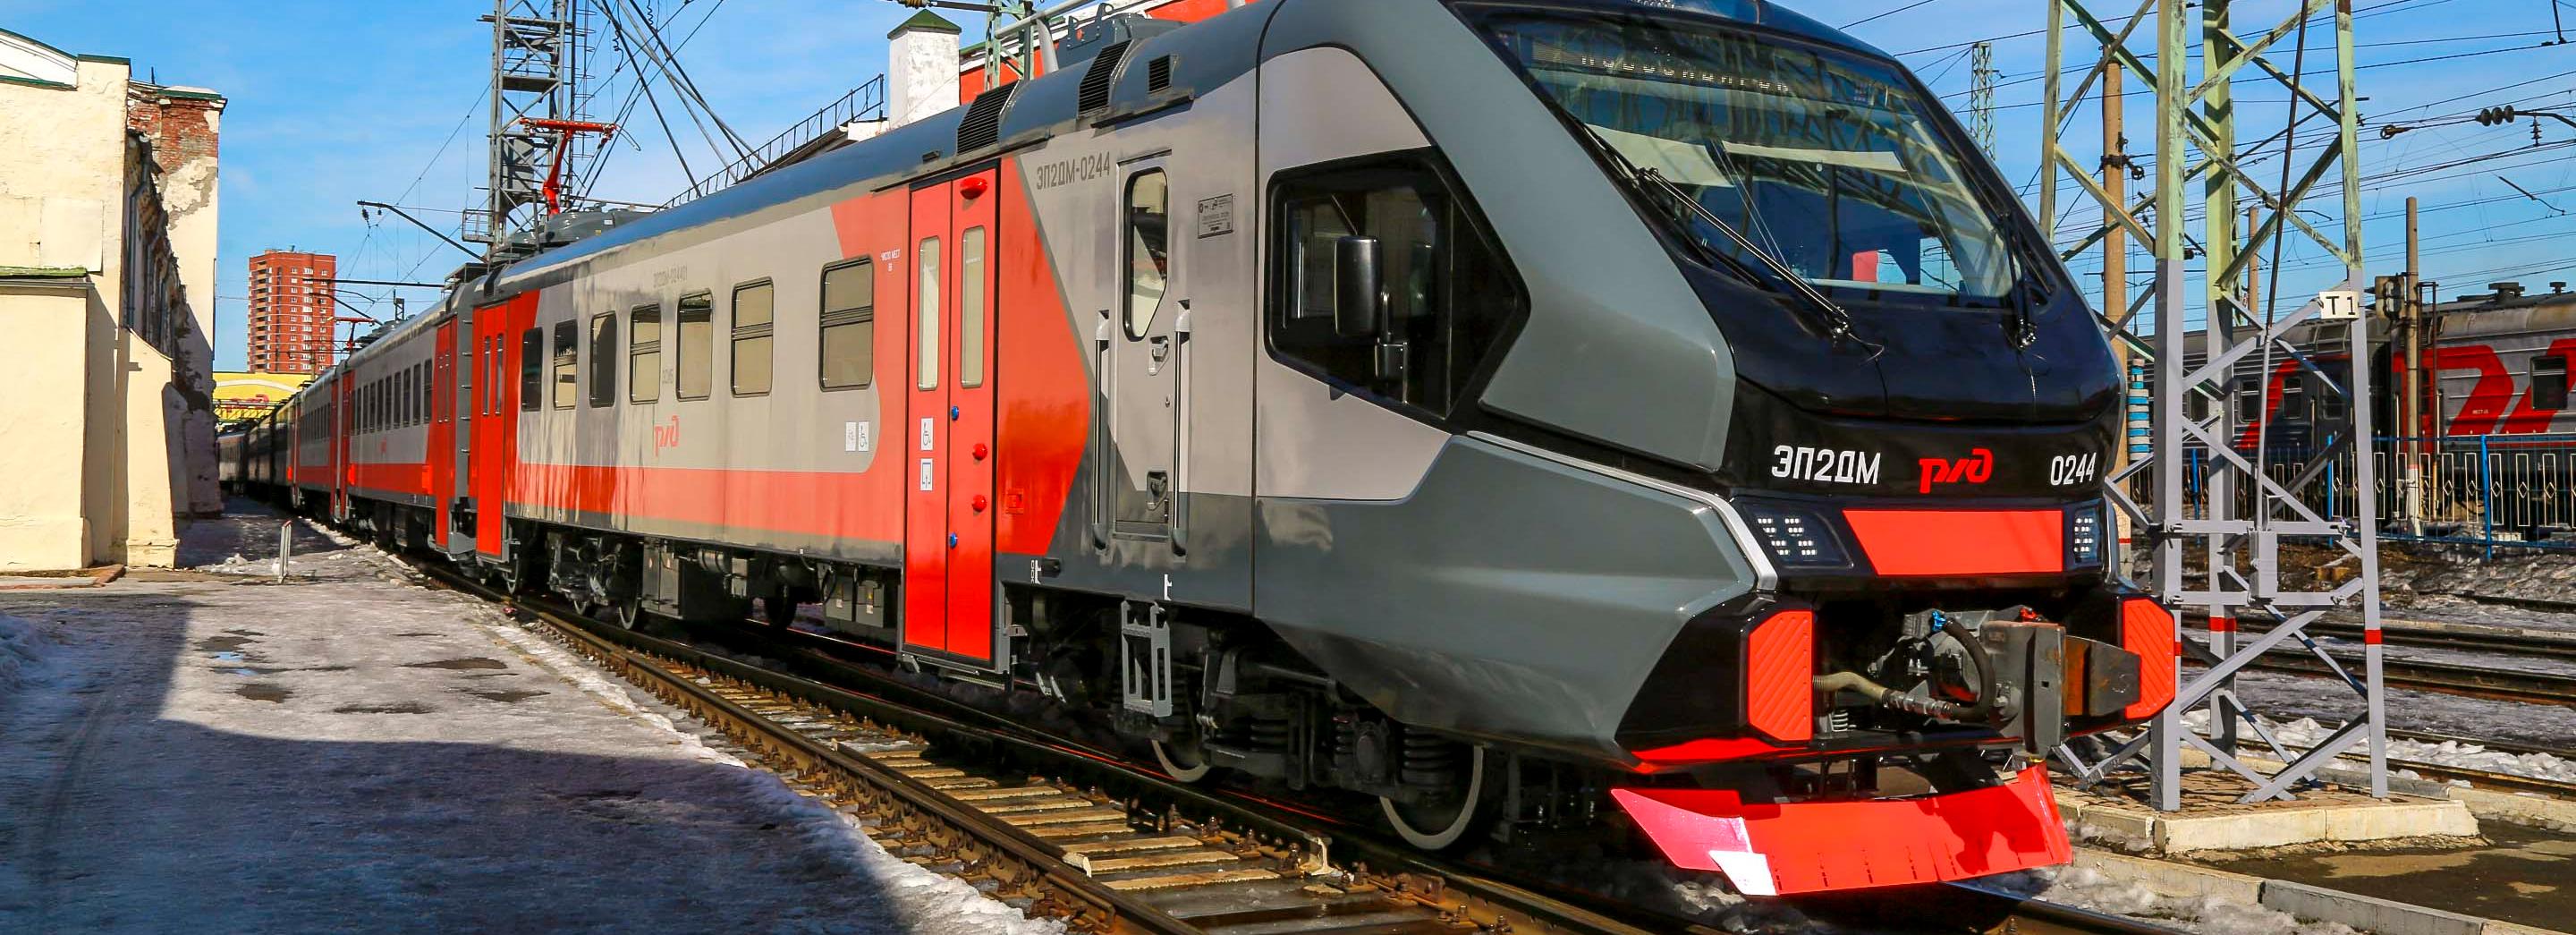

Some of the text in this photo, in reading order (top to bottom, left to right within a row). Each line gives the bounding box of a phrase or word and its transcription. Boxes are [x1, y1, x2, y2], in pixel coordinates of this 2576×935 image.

[1038, 151, 1110, 190] ЭП2ДМ-0244
[1771, 445, 1881, 485] ЭП2ДМ
[2050, 452, 2097, 486] 0244
